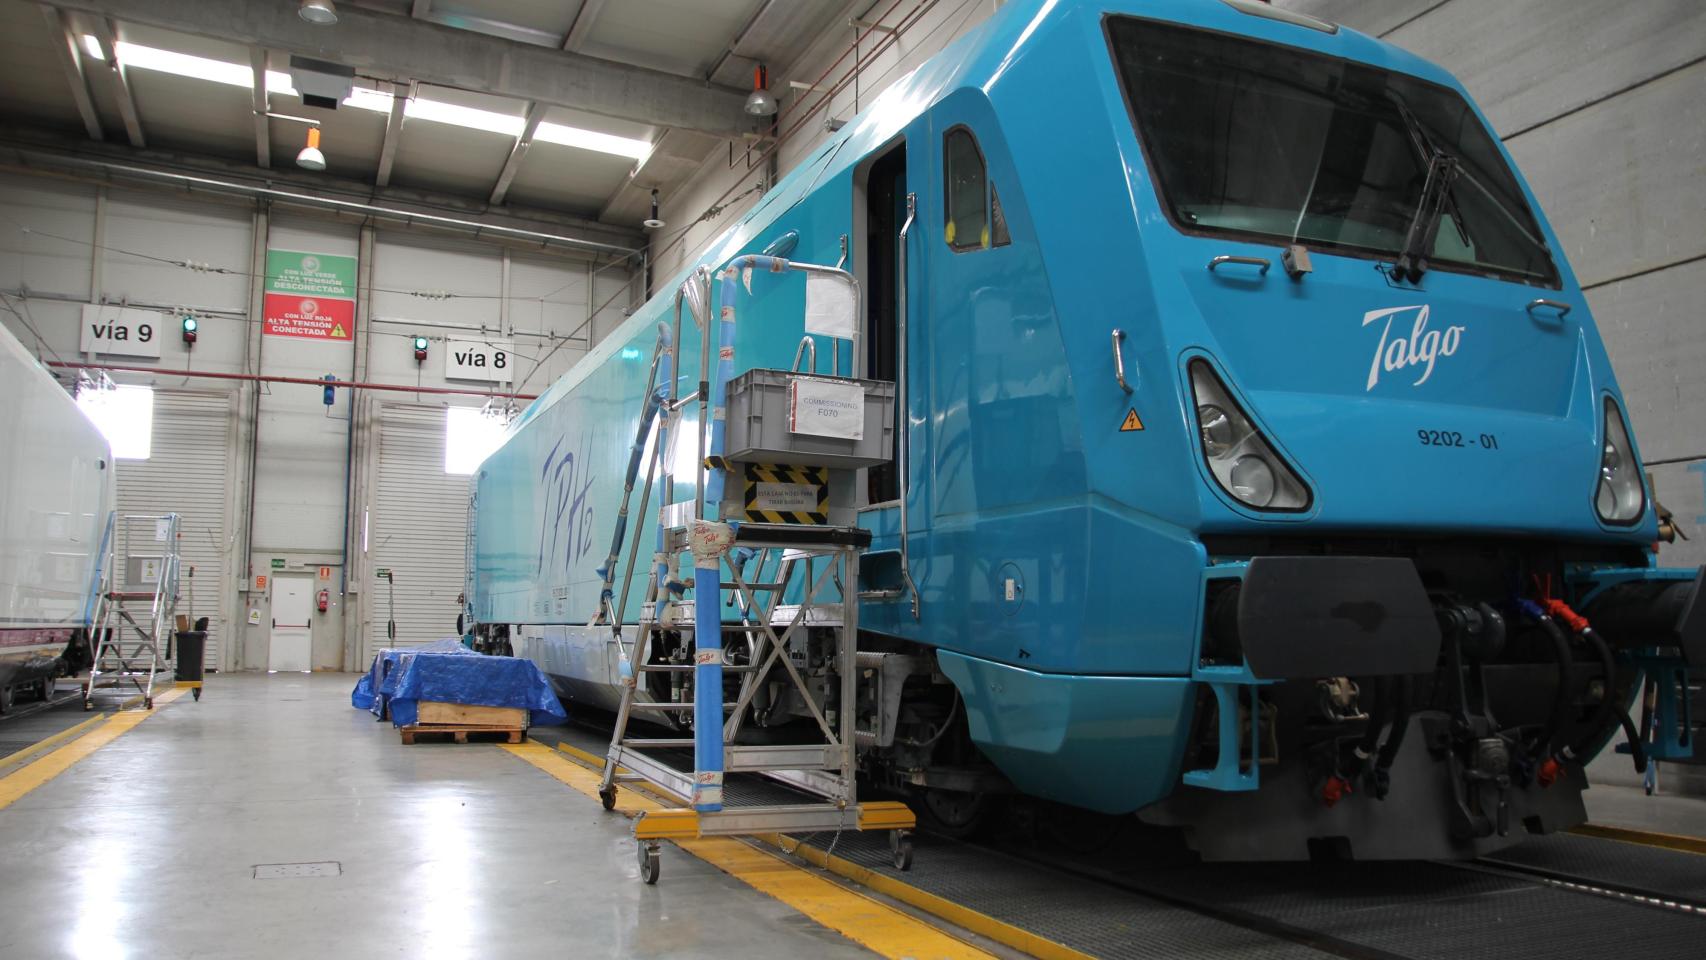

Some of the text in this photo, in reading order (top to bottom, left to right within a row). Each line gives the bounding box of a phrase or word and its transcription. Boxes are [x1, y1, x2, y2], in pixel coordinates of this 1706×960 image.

[278, 275, 300, 283] ALTA
[274, 281, 345, 294] DESCONECTADA
[92, 319, 153, 343] vía 9
[272, 325, 327, 336] CONECTADA
[1362, 304, 1466, 392] Talgo
[455, 347, 506, 369] vía 8
[803, 397, 858, 410] COMMISSIONING
[817, 408, 839, 417] F070
[1418, 430, 1465, 447] 9202
[1480, 434, 1498, 450] 01
